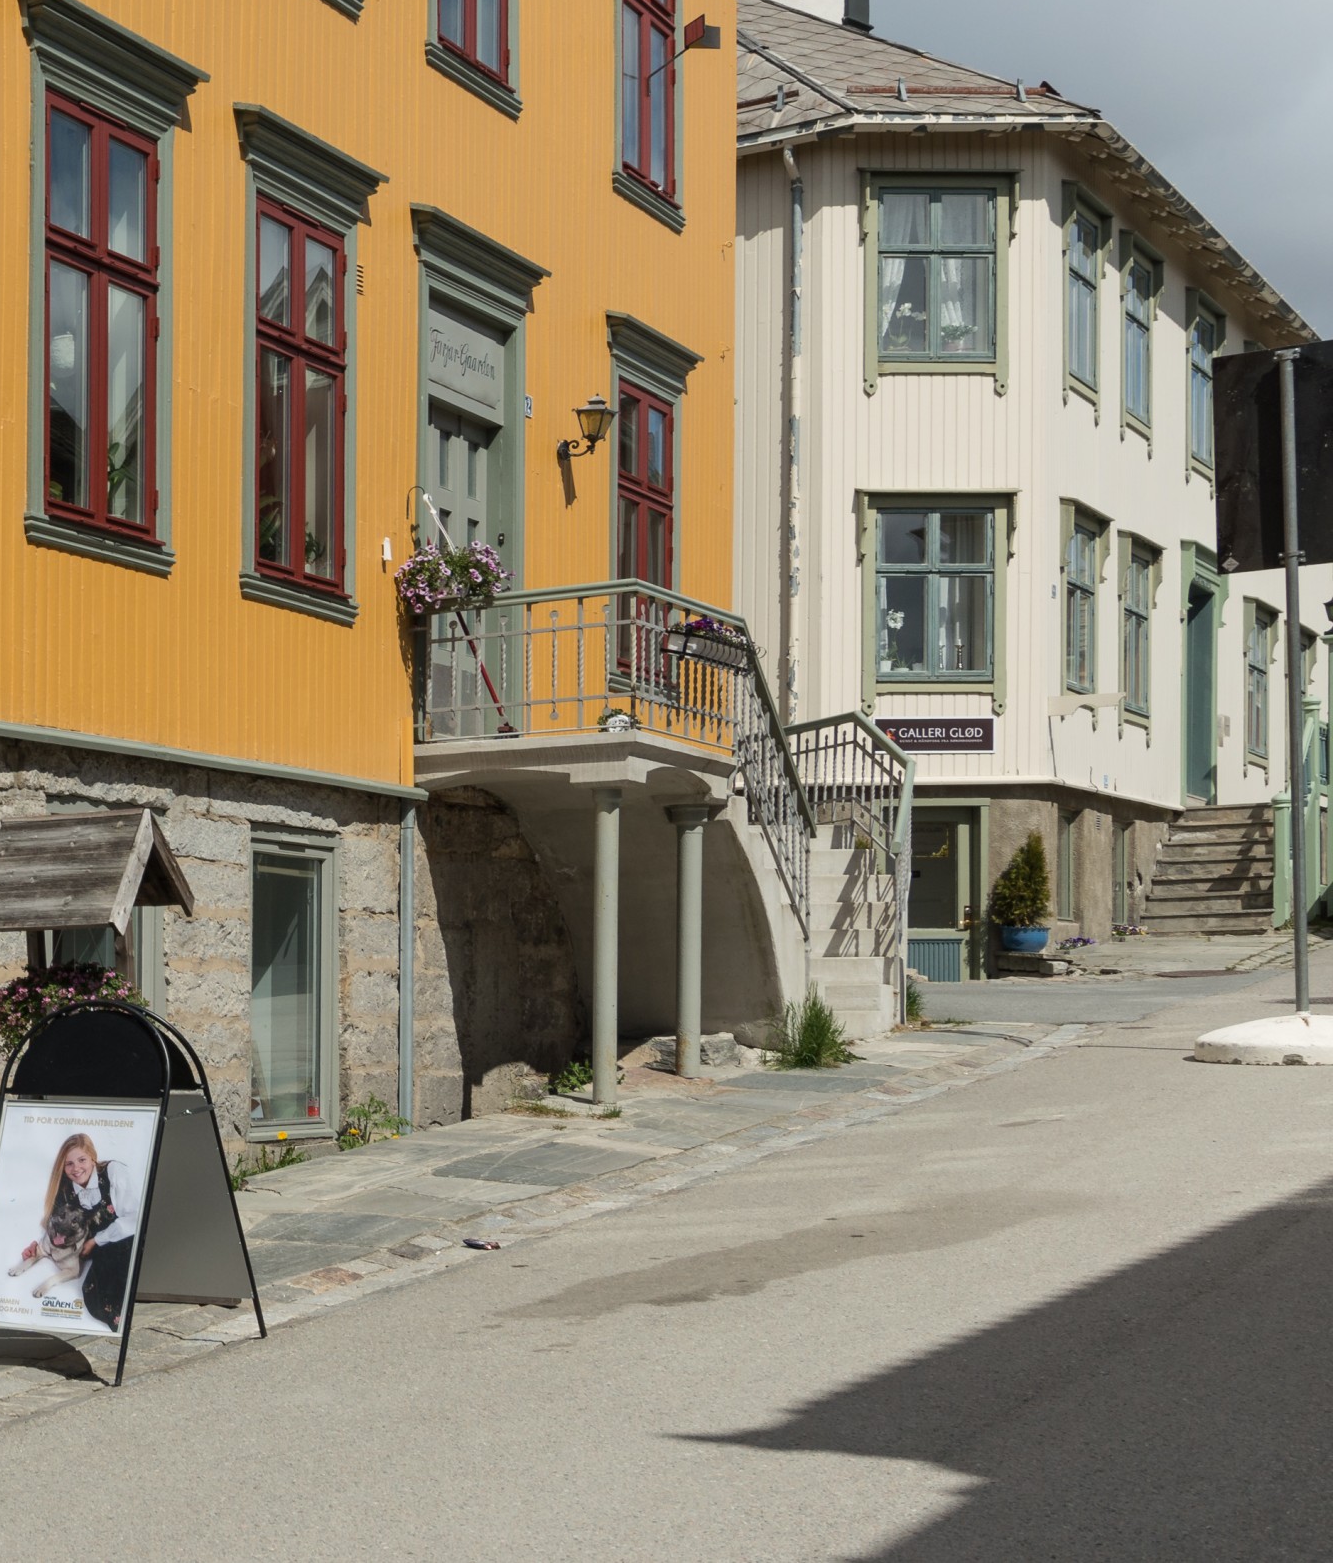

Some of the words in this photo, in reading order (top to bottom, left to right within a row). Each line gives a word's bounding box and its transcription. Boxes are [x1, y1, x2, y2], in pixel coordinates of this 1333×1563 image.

[898, 727, 946, 738] GALLERI
[949, 727, 983, 738] GLØD
[54, 1117, 134, 1127] KONFIRMANTBILDENE
[42, 1299, 71, 1309] GALÅEN
